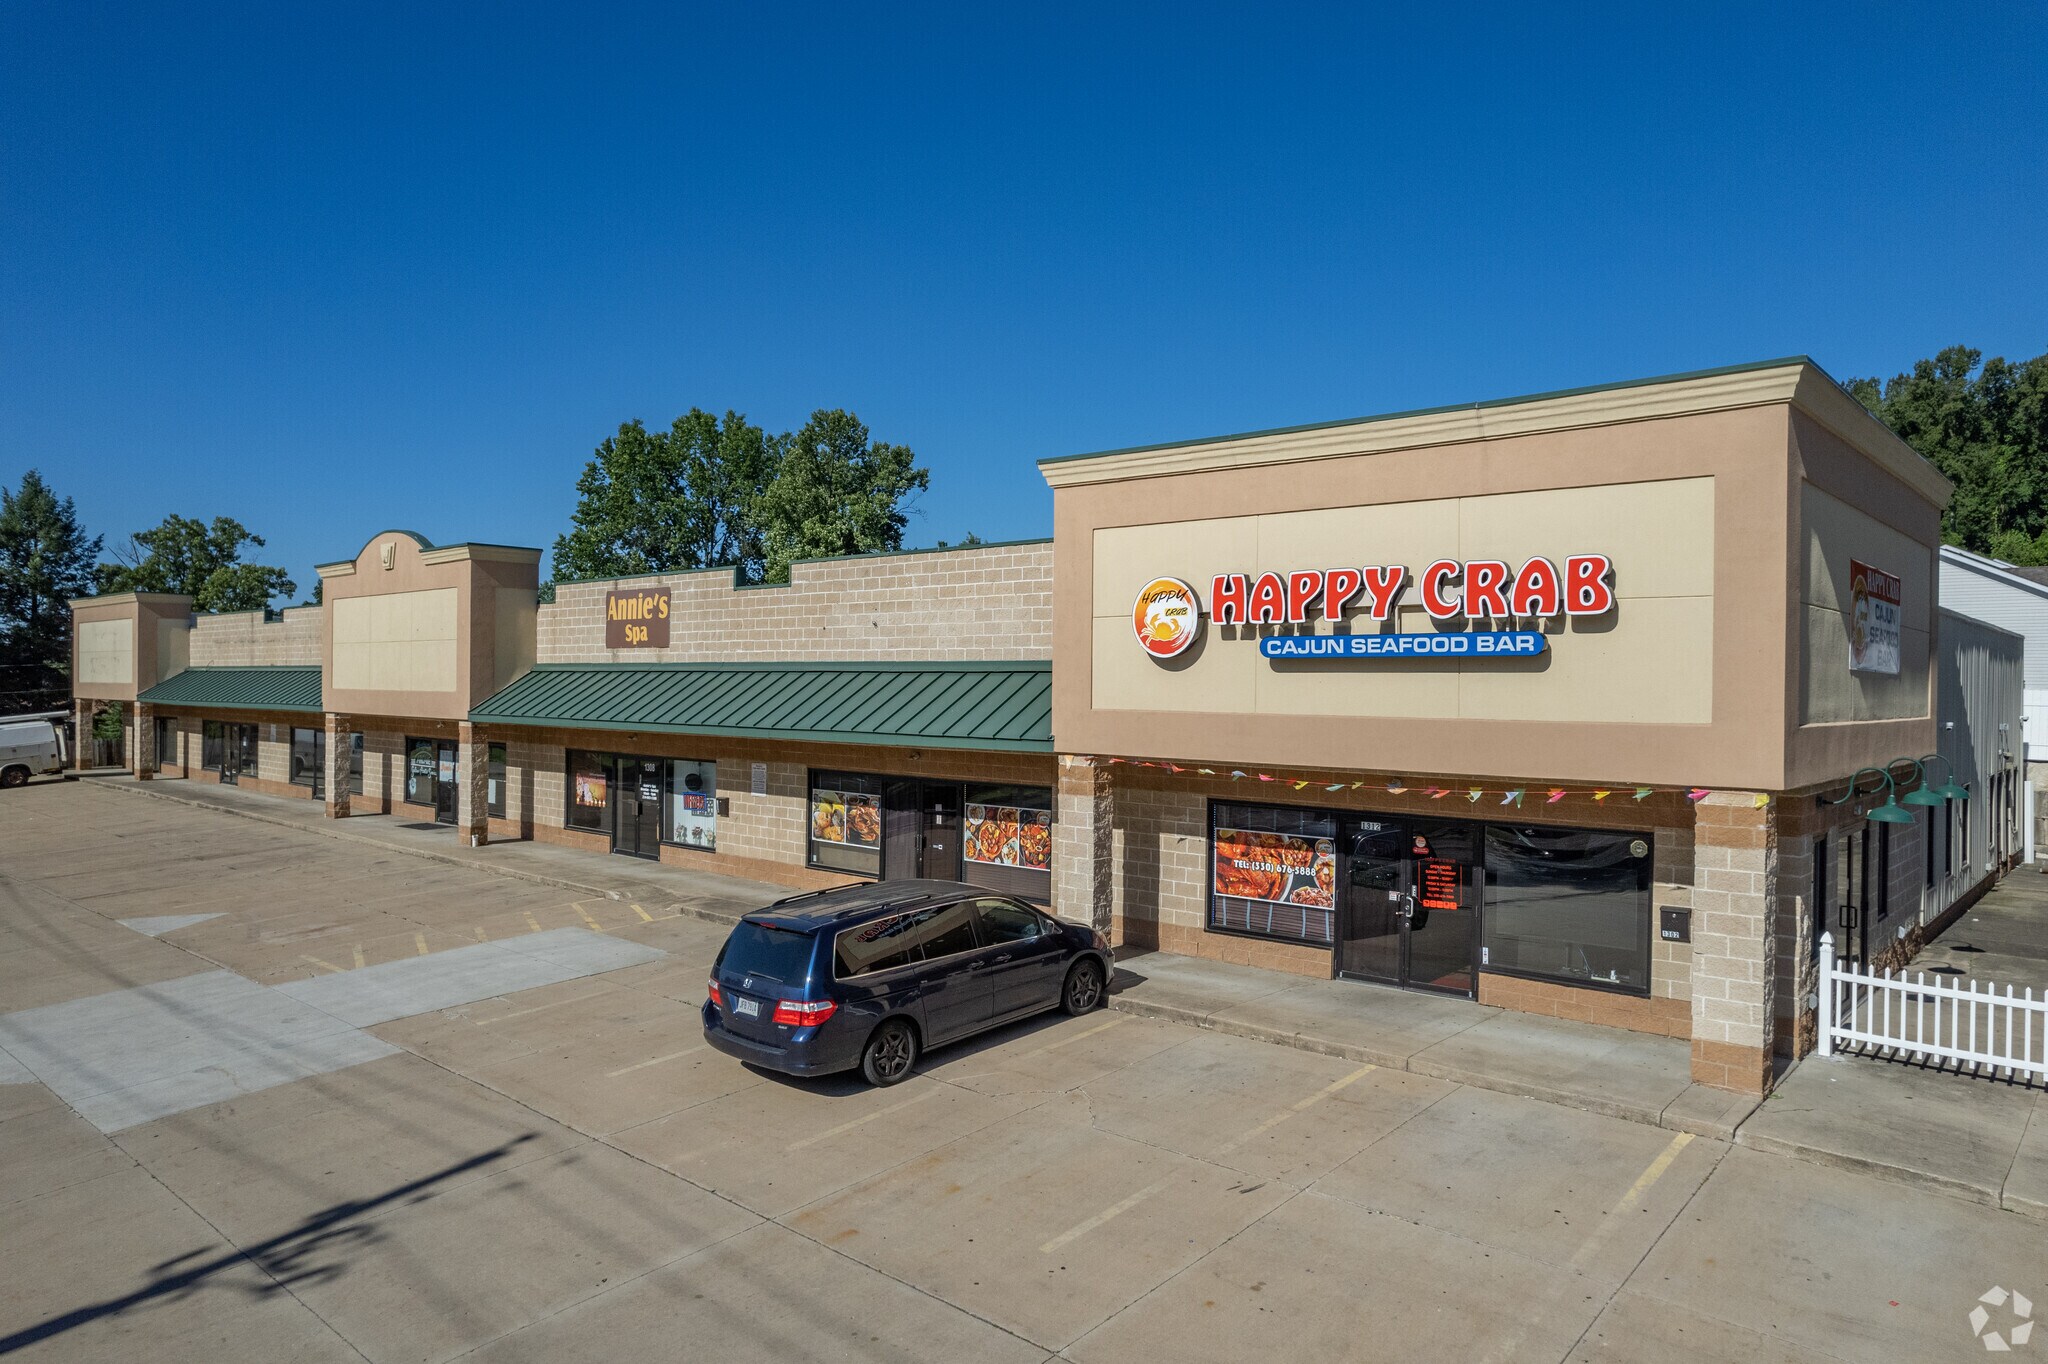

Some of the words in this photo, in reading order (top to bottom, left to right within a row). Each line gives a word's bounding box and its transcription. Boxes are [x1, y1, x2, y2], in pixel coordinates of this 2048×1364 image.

[1210, 564, 1408, 626] HAPPY
[1421, 553, 1613, 619] CRAB
[1867, 570, 1885, 596] HAPPY
[608, 592, 669, 621] Annie's
[1875, 604, 1896, 625] CAJUN
[625, 624, 648, 645] Spa
[1266, 639, 1345, 656] CAJUN
[1351, 635, 1471, 655] SEAFOOD
[1476, 633, 1535, 652] BAR
[1869, 626, 1898, 648] SEAFOOD
[1361, 822, 1381, 831] 1312
[1233, 859, 1249, 869] TEL:
[1251, 863, 1274, 873] (330)
[1276, 866, 1316, 877] 676-5888
